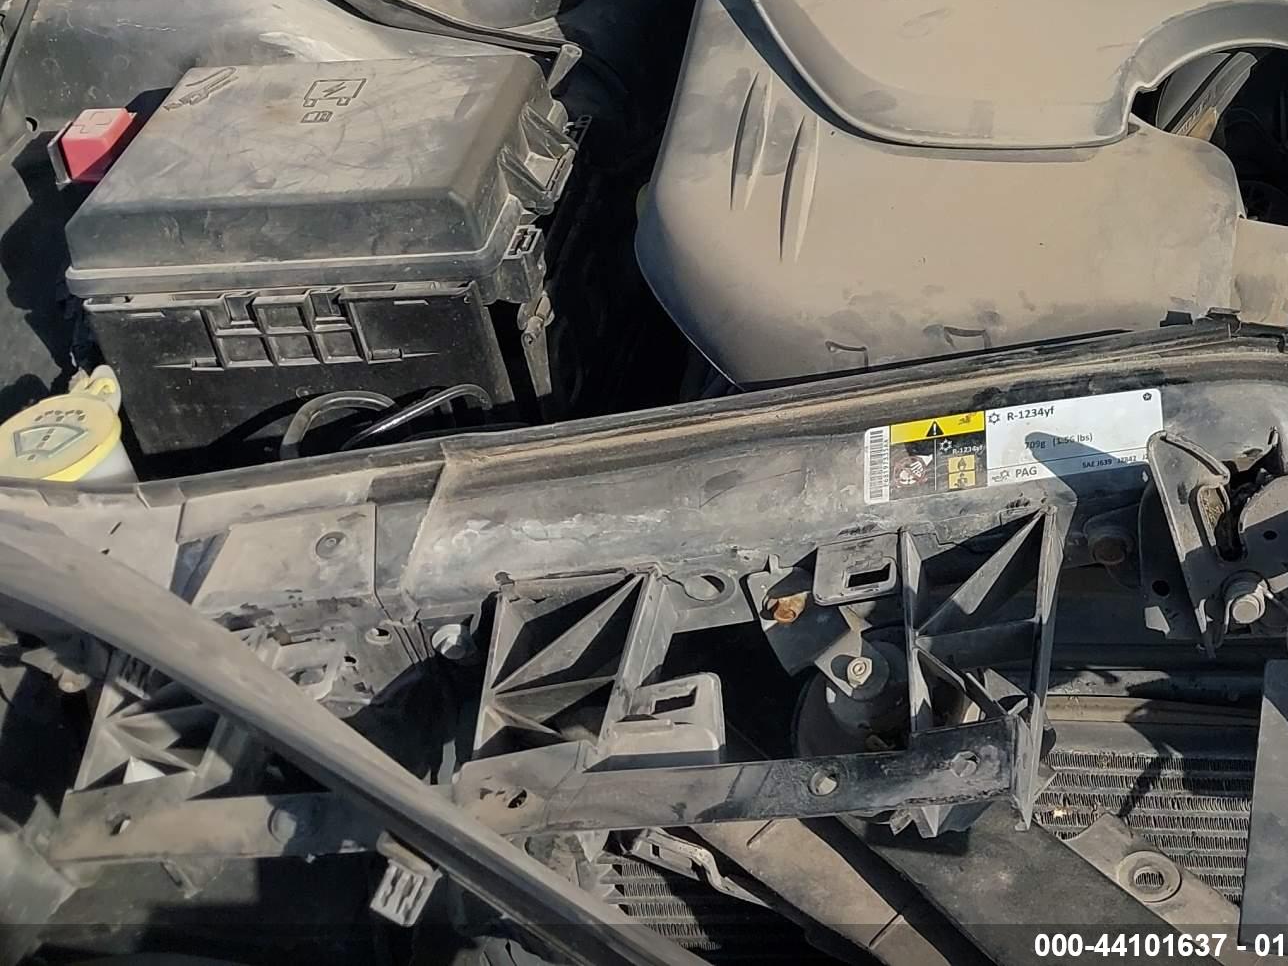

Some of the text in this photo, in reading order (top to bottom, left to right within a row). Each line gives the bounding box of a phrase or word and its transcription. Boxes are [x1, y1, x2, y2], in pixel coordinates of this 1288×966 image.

[1007, 406, 1054, 421] R-1234yf
[1077, 432, 1093, 443] lbs)
[1015, 466, 1037, 478] PAG
